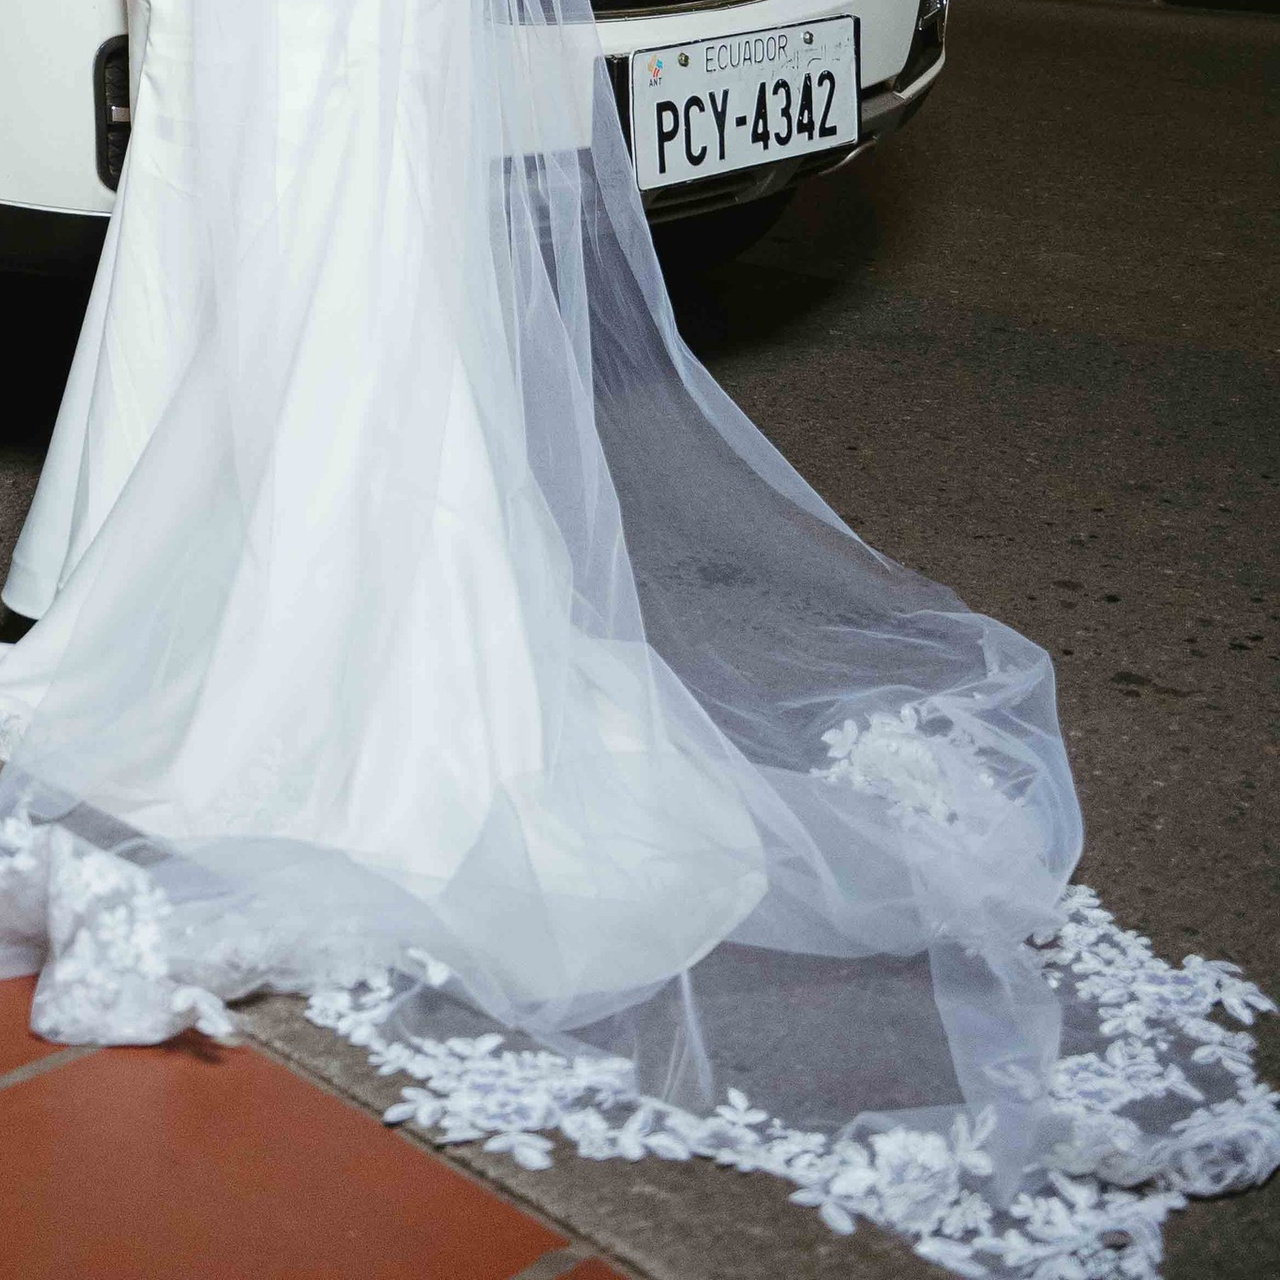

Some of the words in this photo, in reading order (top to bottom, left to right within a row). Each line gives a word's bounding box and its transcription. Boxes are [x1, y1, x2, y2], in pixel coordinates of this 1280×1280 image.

[705, 34, 788, 73] ECUADOR
[648, 77, 662, 88] ANT
[655, 70, 837, 175] PCY-4342
